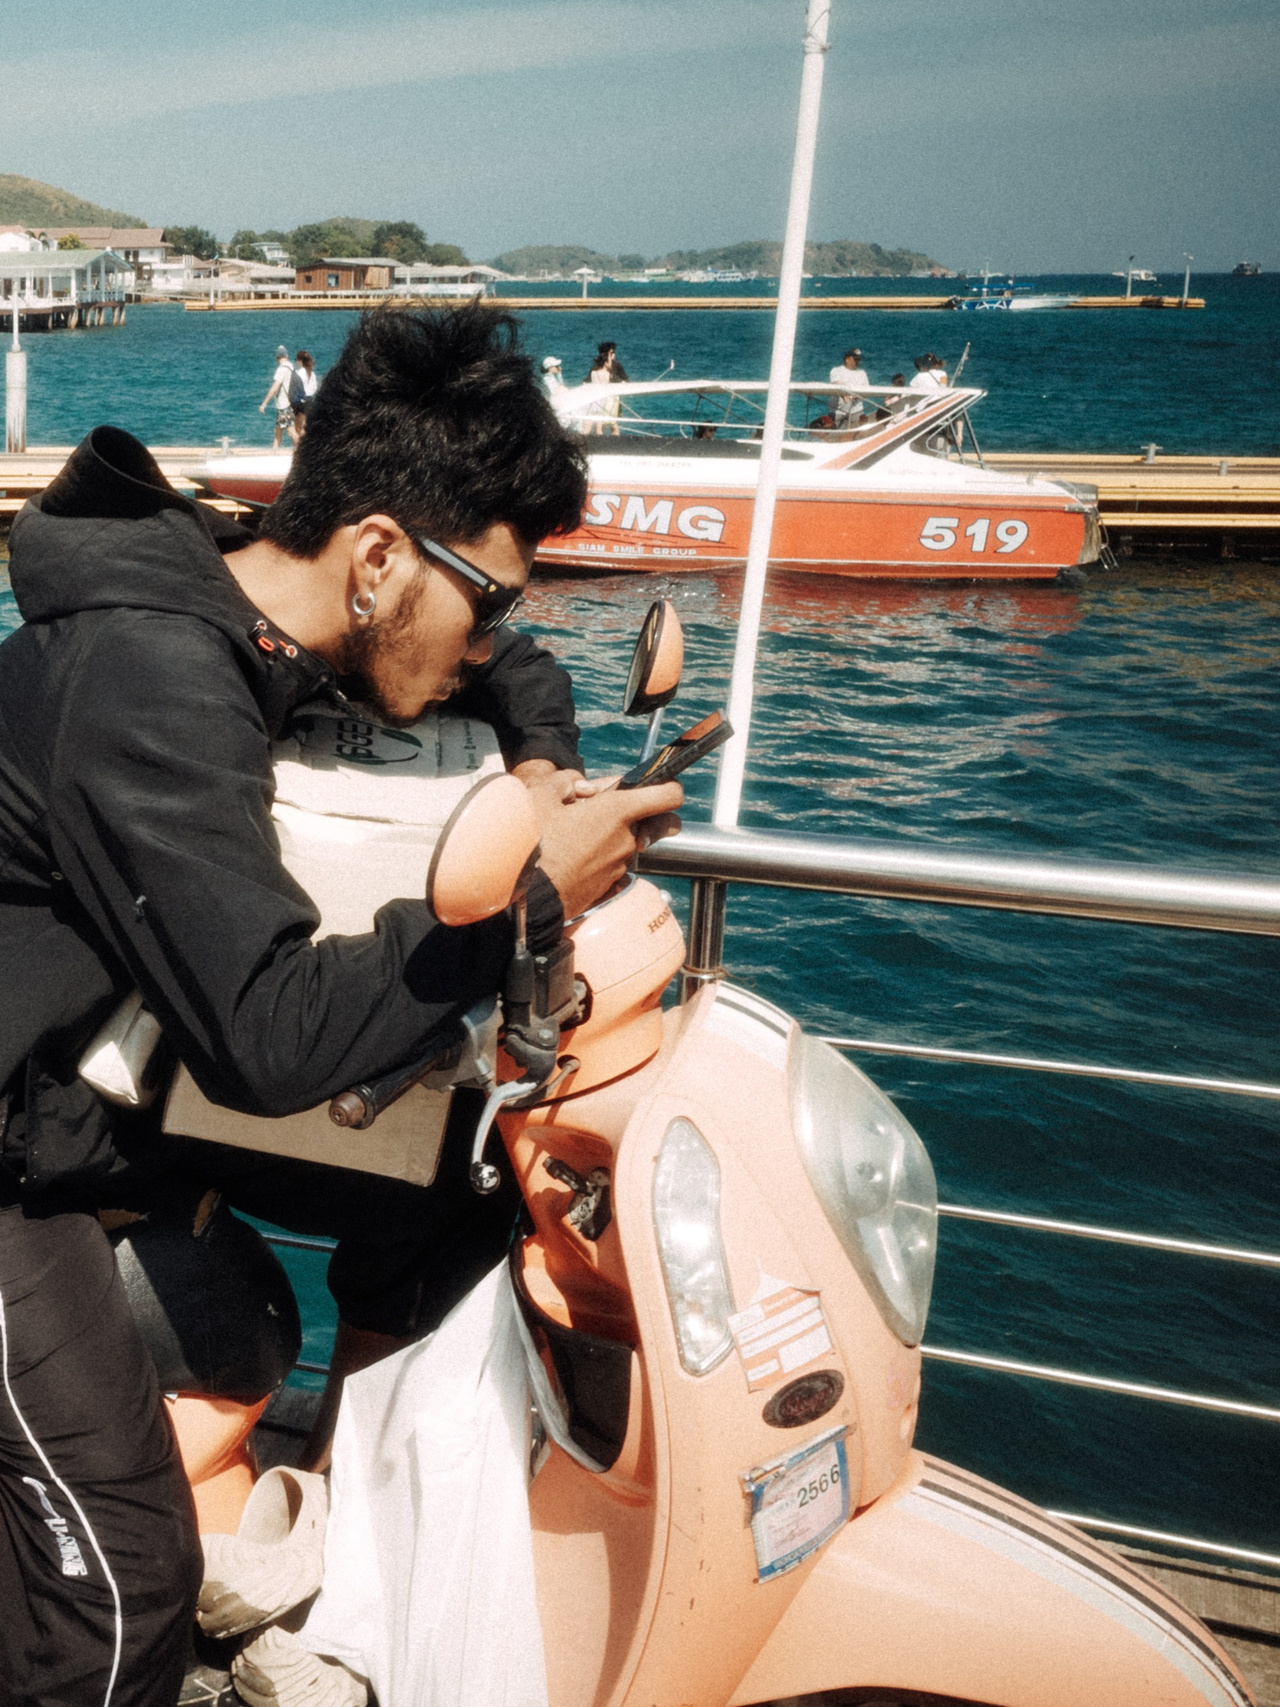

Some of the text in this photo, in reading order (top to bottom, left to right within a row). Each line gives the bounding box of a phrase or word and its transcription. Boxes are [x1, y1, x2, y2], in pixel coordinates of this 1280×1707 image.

[584, 493, 726, 543] SMG
[918, 515, 1030, 554] 519
[577, 543, 697, 557] SIAM SMILE GROUP
[797, 1463, 840, 1508] 2566
